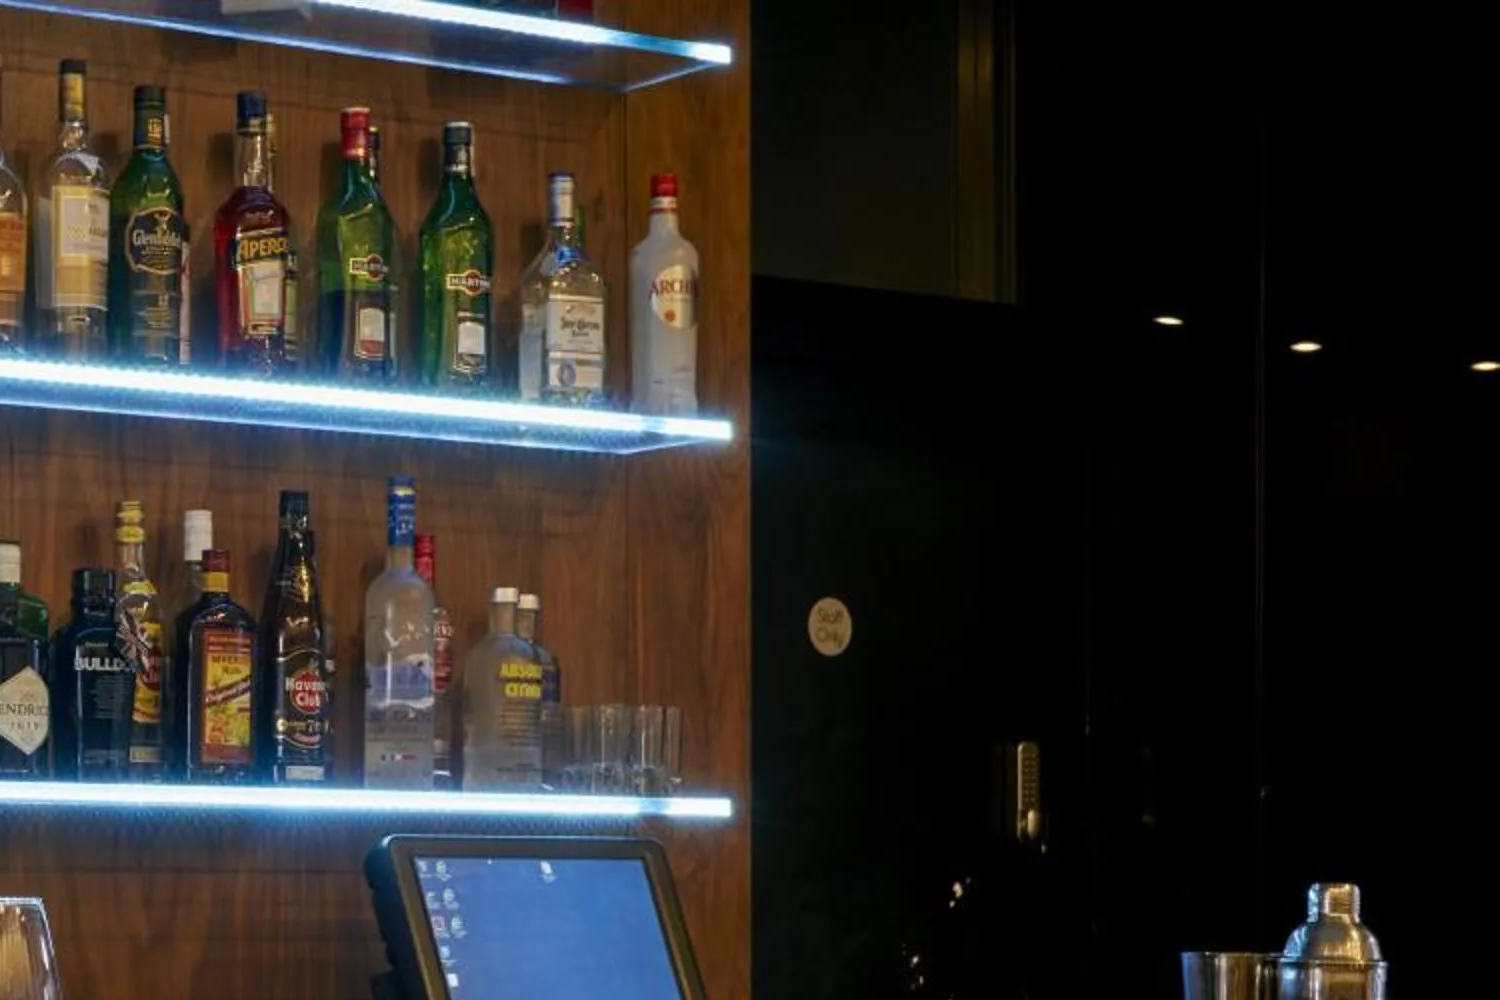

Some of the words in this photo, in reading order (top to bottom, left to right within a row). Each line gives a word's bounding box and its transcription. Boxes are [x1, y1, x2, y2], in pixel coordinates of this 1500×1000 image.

[238, 237, 289, 261] APERO
[451, 277, 491, 290] MARTIN
[74, 656, 136, 672] BULLDO
